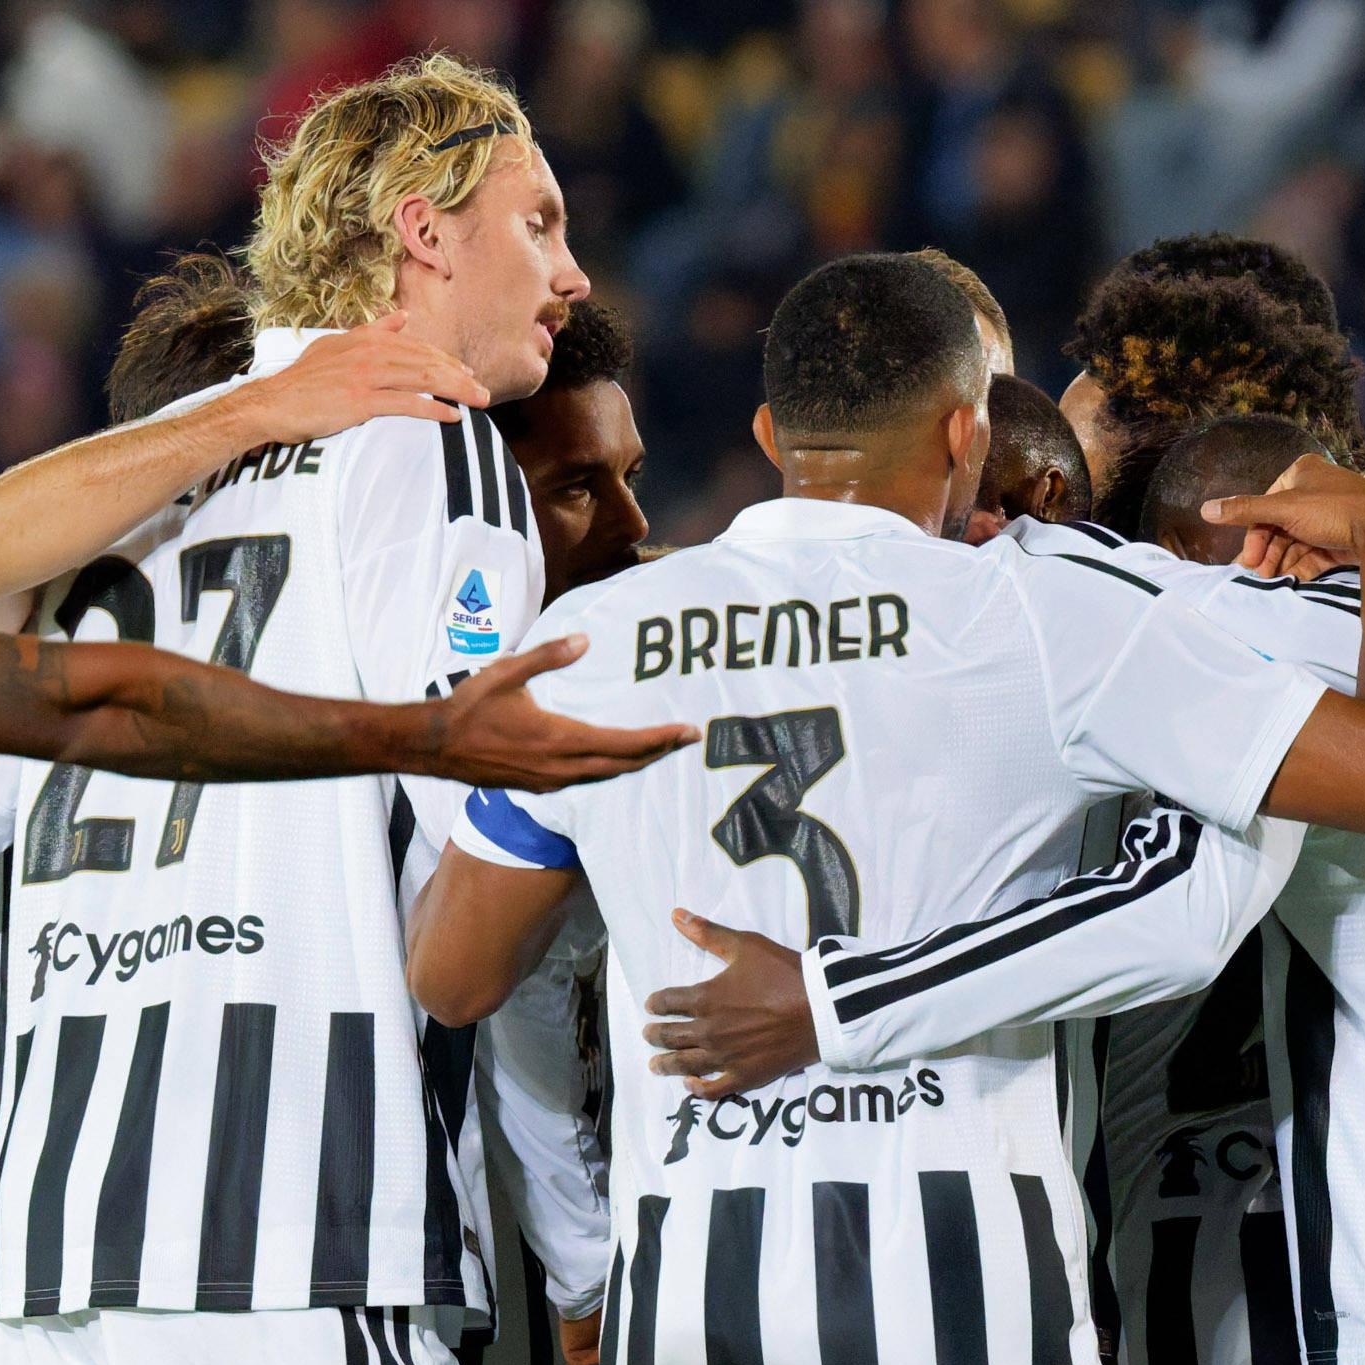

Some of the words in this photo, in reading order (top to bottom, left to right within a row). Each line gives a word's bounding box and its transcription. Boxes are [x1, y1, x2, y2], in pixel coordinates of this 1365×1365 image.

[452, 612, 482, 626] SERIE
[485, 618, 493, 626] A
[634, 593, 910, 684] BREMER
[704, 706, 861, 945] 3
[52, 914, 265, 986] Cygames
